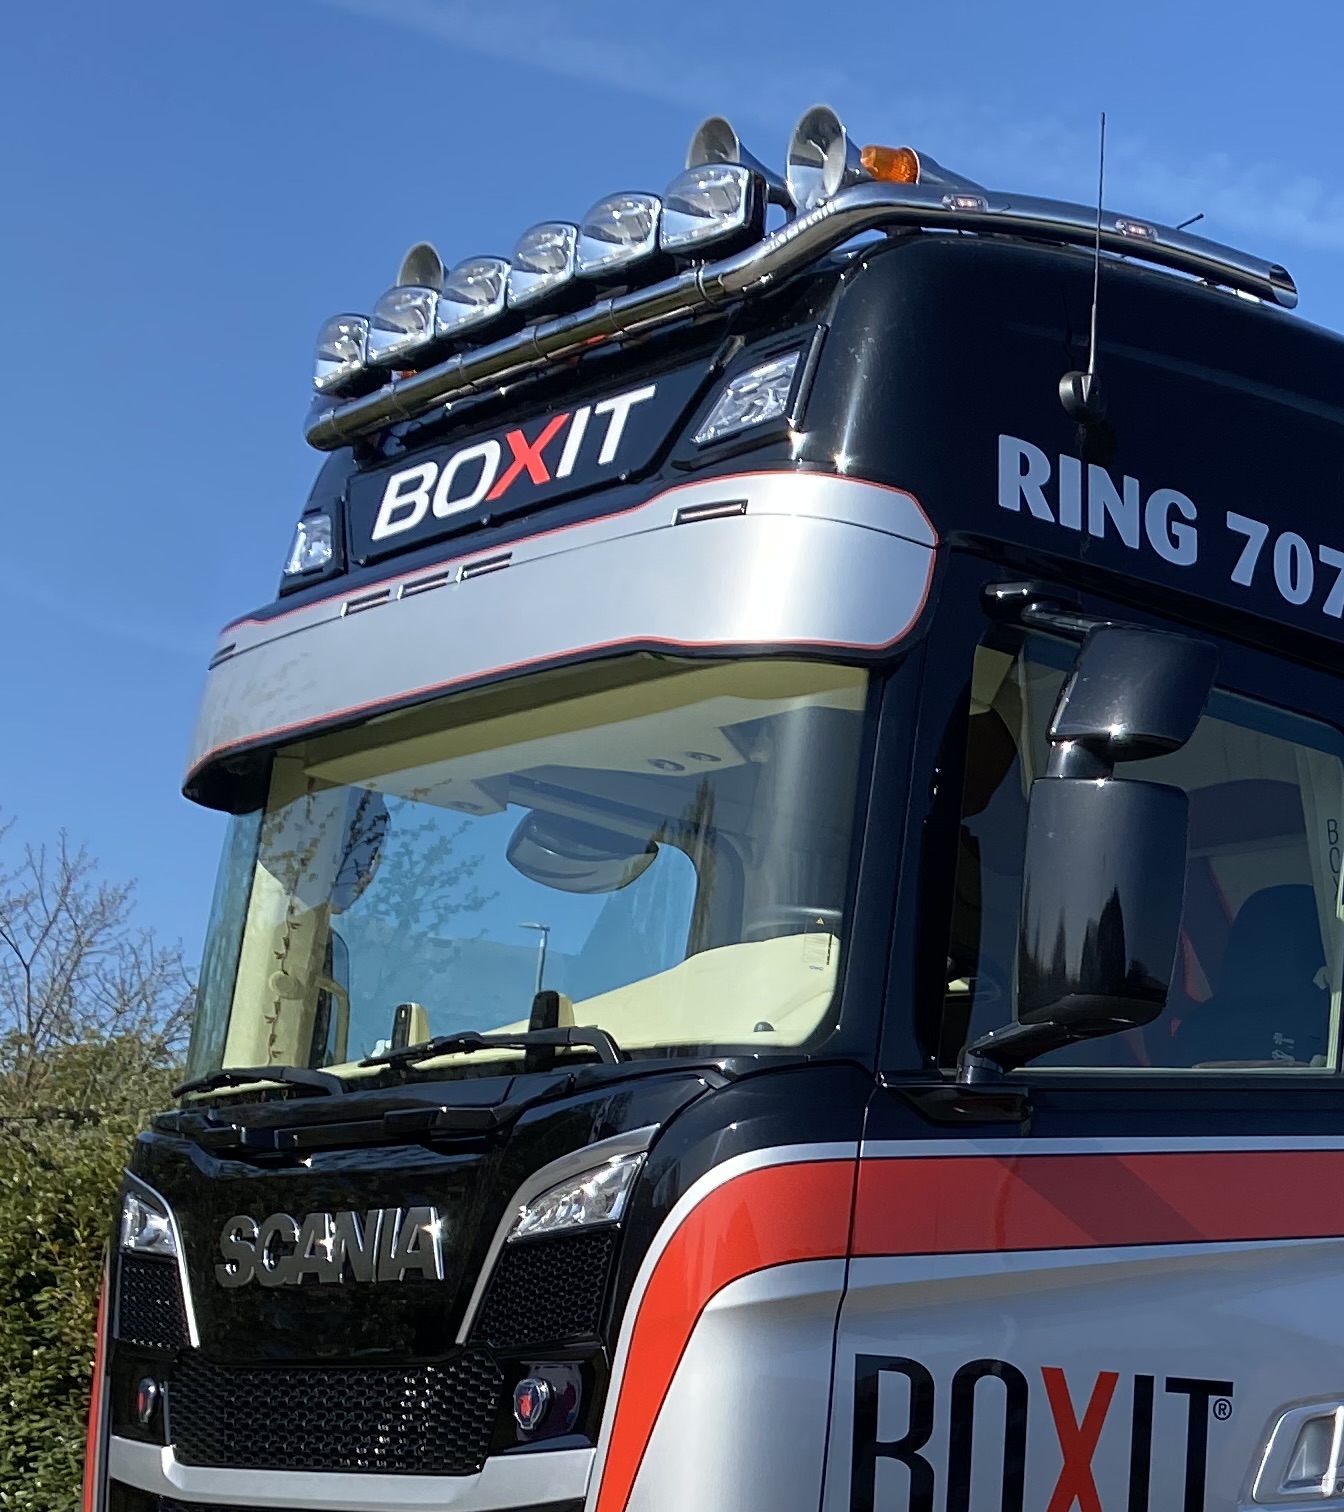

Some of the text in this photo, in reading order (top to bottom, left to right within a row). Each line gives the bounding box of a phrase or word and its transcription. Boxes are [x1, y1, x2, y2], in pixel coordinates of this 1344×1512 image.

[371, 383, 658, 543] BOXIT
[998, 433, 1198, 566] RING
[215, 1206, 445, 1288] SCANIA
